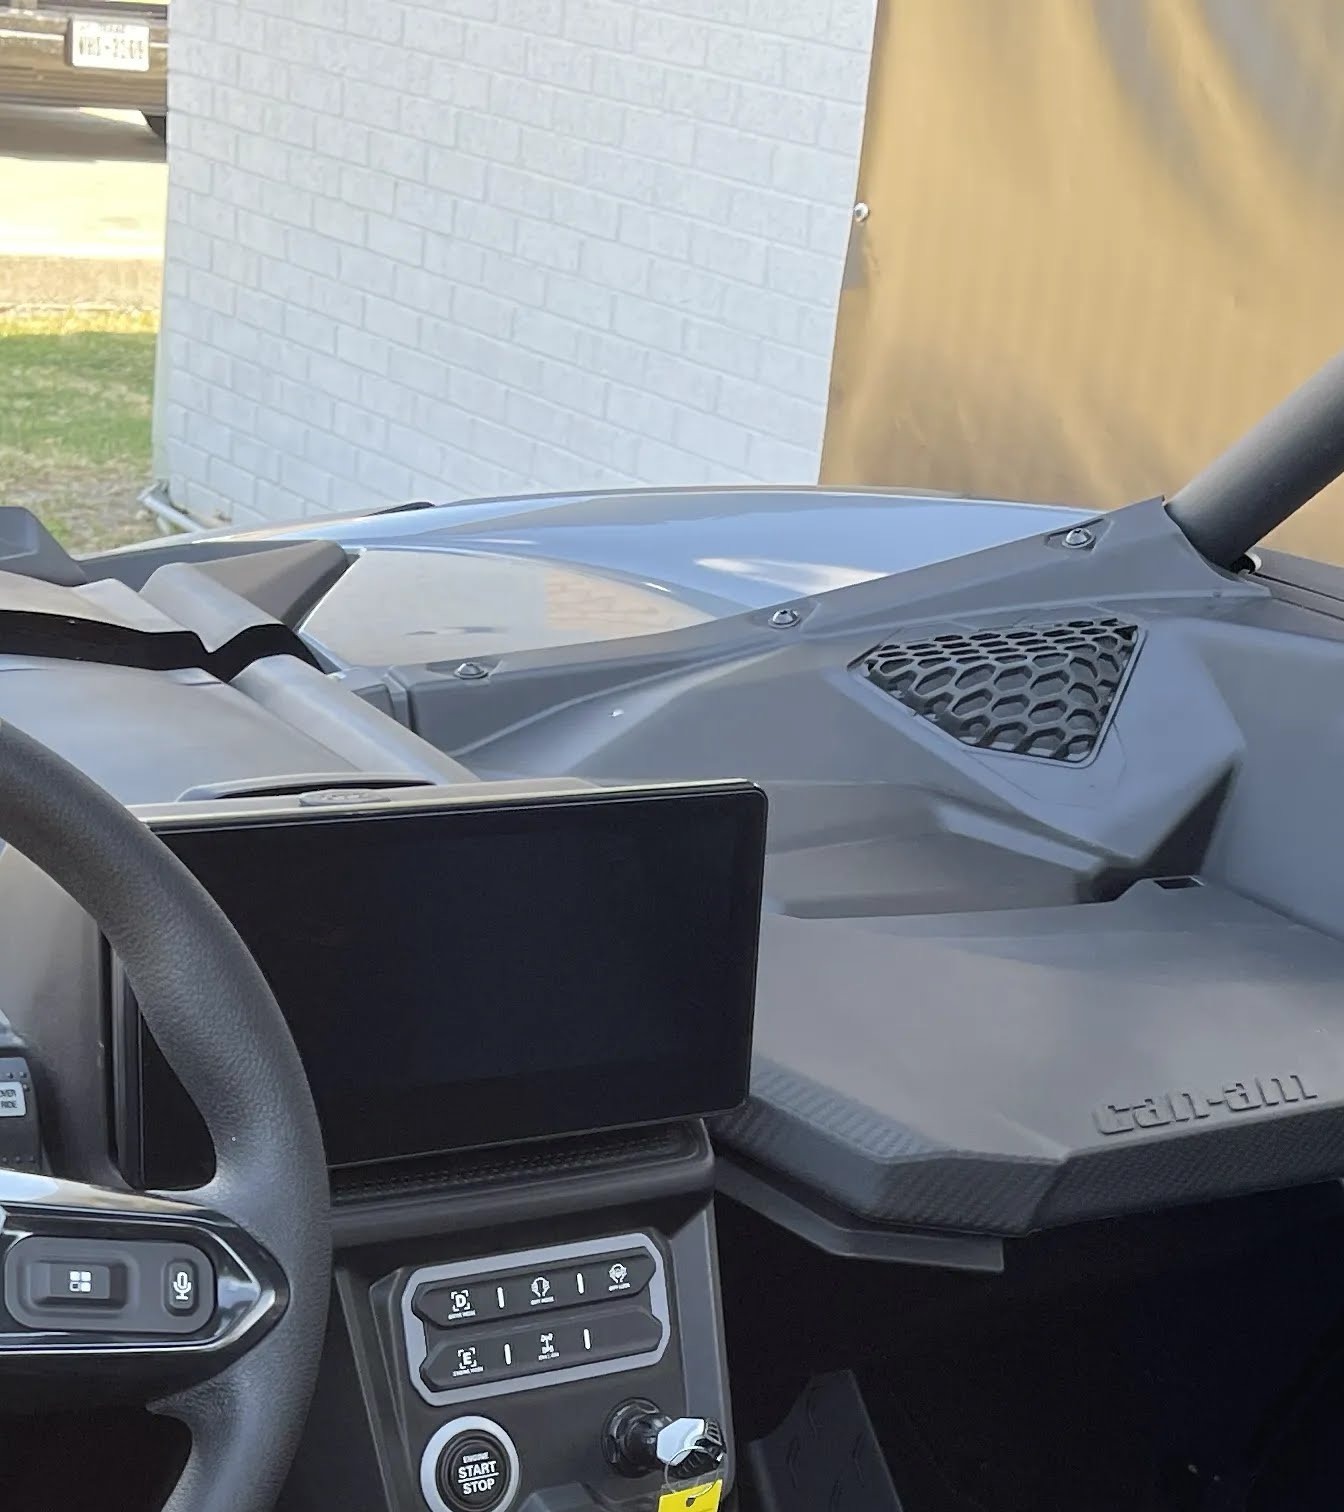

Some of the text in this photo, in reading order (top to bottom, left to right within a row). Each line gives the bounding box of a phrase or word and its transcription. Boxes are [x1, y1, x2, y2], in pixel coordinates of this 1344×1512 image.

[1090, 1074, 1318, 1136] can-am
[458, 1460, 497, 1479] START
[463, 1478, 495, 1495] STOP
